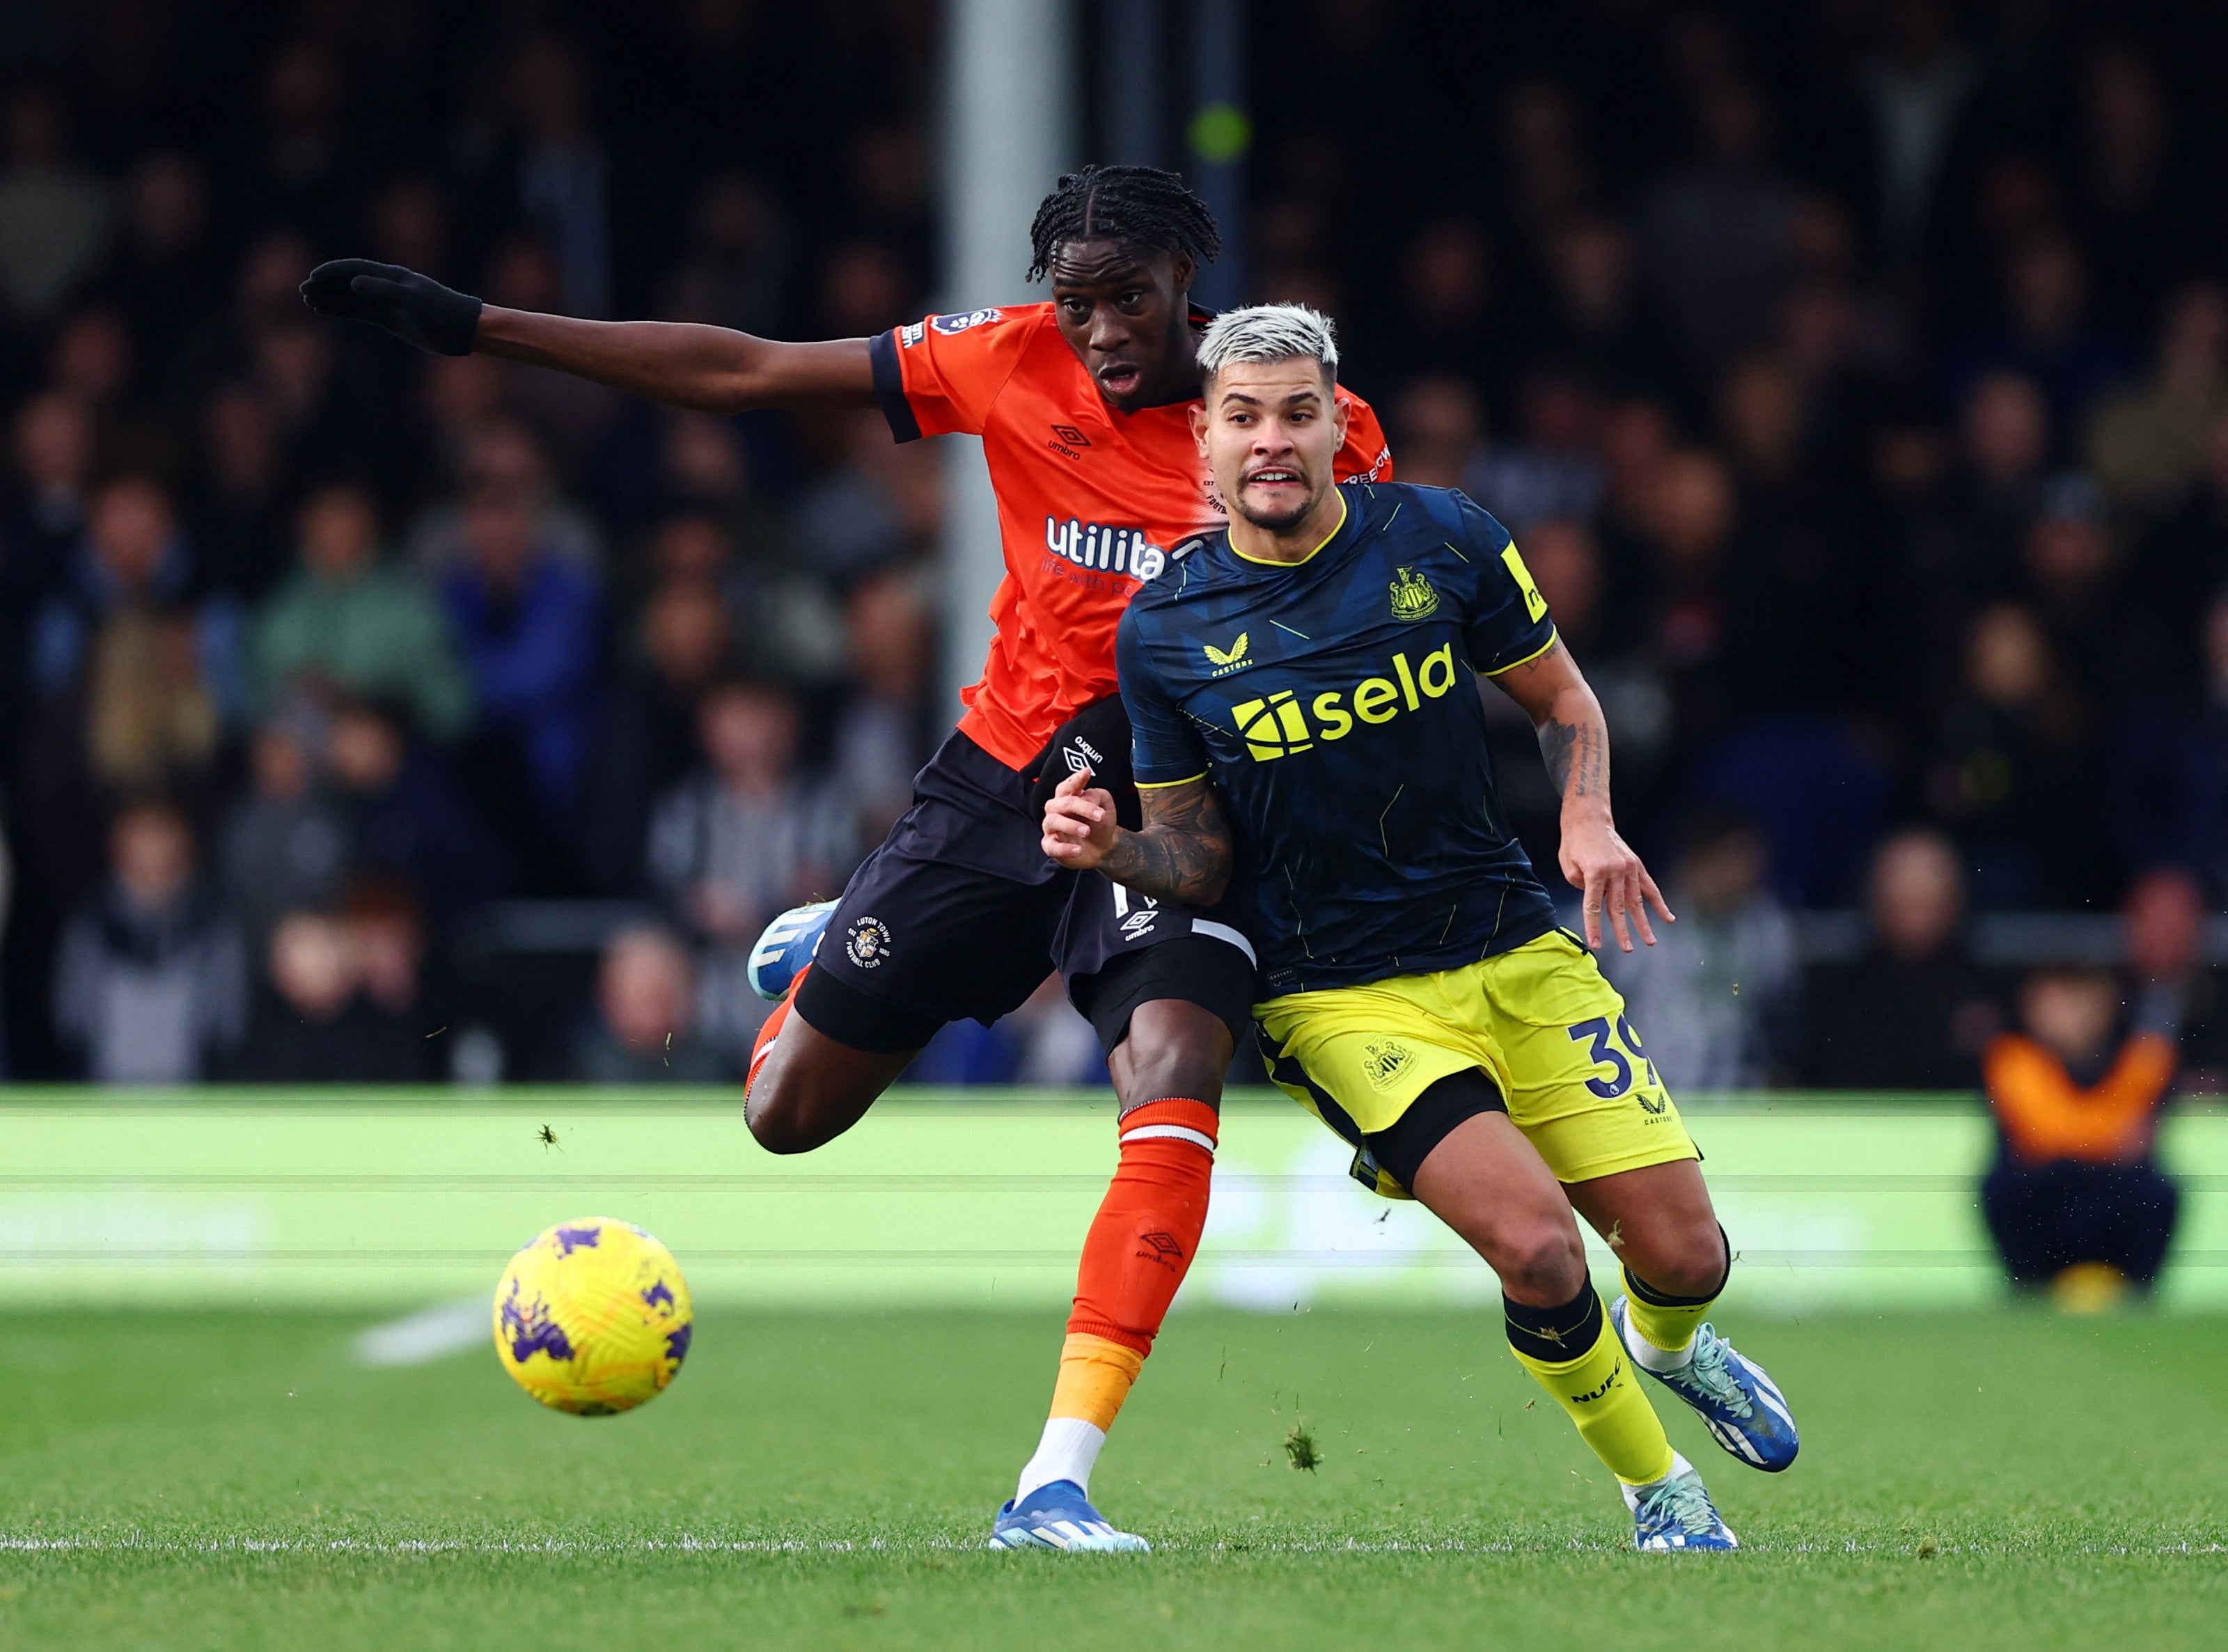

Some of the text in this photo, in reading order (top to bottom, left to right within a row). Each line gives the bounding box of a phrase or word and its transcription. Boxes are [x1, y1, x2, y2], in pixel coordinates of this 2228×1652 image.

[1048, 440, 1081, 460] umbro
[1206, 495, 1227, 514] FOOTB
[1046, 516, 1166, 582] utilita
[1041, 556, 1134, 599] life with po
[1211, 659, 1254, 677] CASTORE
[1312, 642, 1456, 741] sela
[1074, 736, 1104, 764] umbro
[856, 916, 891, 943] LUTON TOWN
[1124, 925, 1155, 941] umbro
[846, 941, 881, 968] FOOTBALL CLUB
[1567, 1012, 1658, 1099] 39
[1136, 1250, 1176, 1273] umbro
